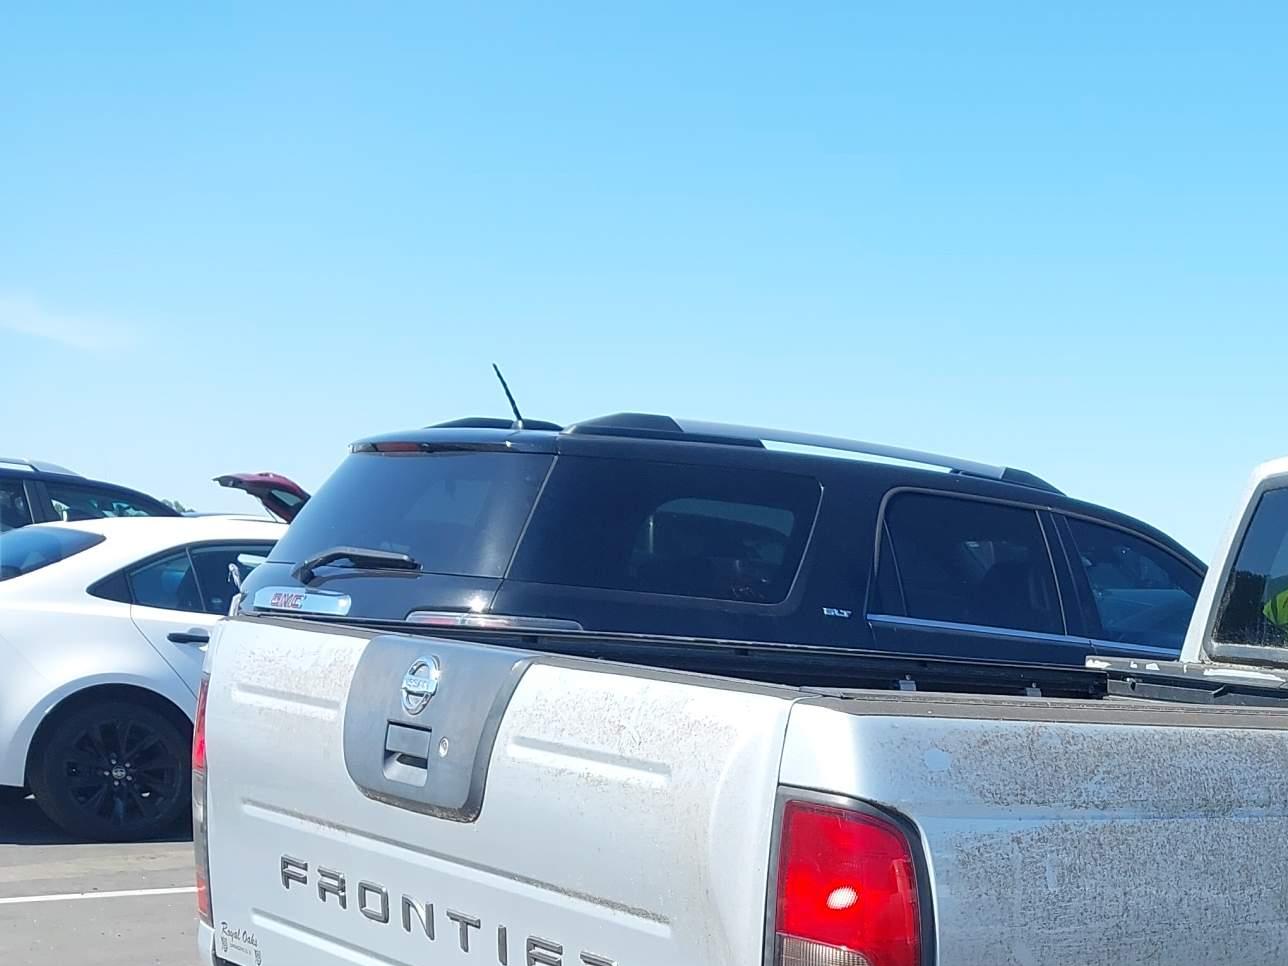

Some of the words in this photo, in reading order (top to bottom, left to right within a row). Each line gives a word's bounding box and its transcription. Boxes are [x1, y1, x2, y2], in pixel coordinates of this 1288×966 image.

[270, 592, 305, 609] GMC
[220, 920, 241, 942] Royal
[242, 929, 258, 948] Oaks
